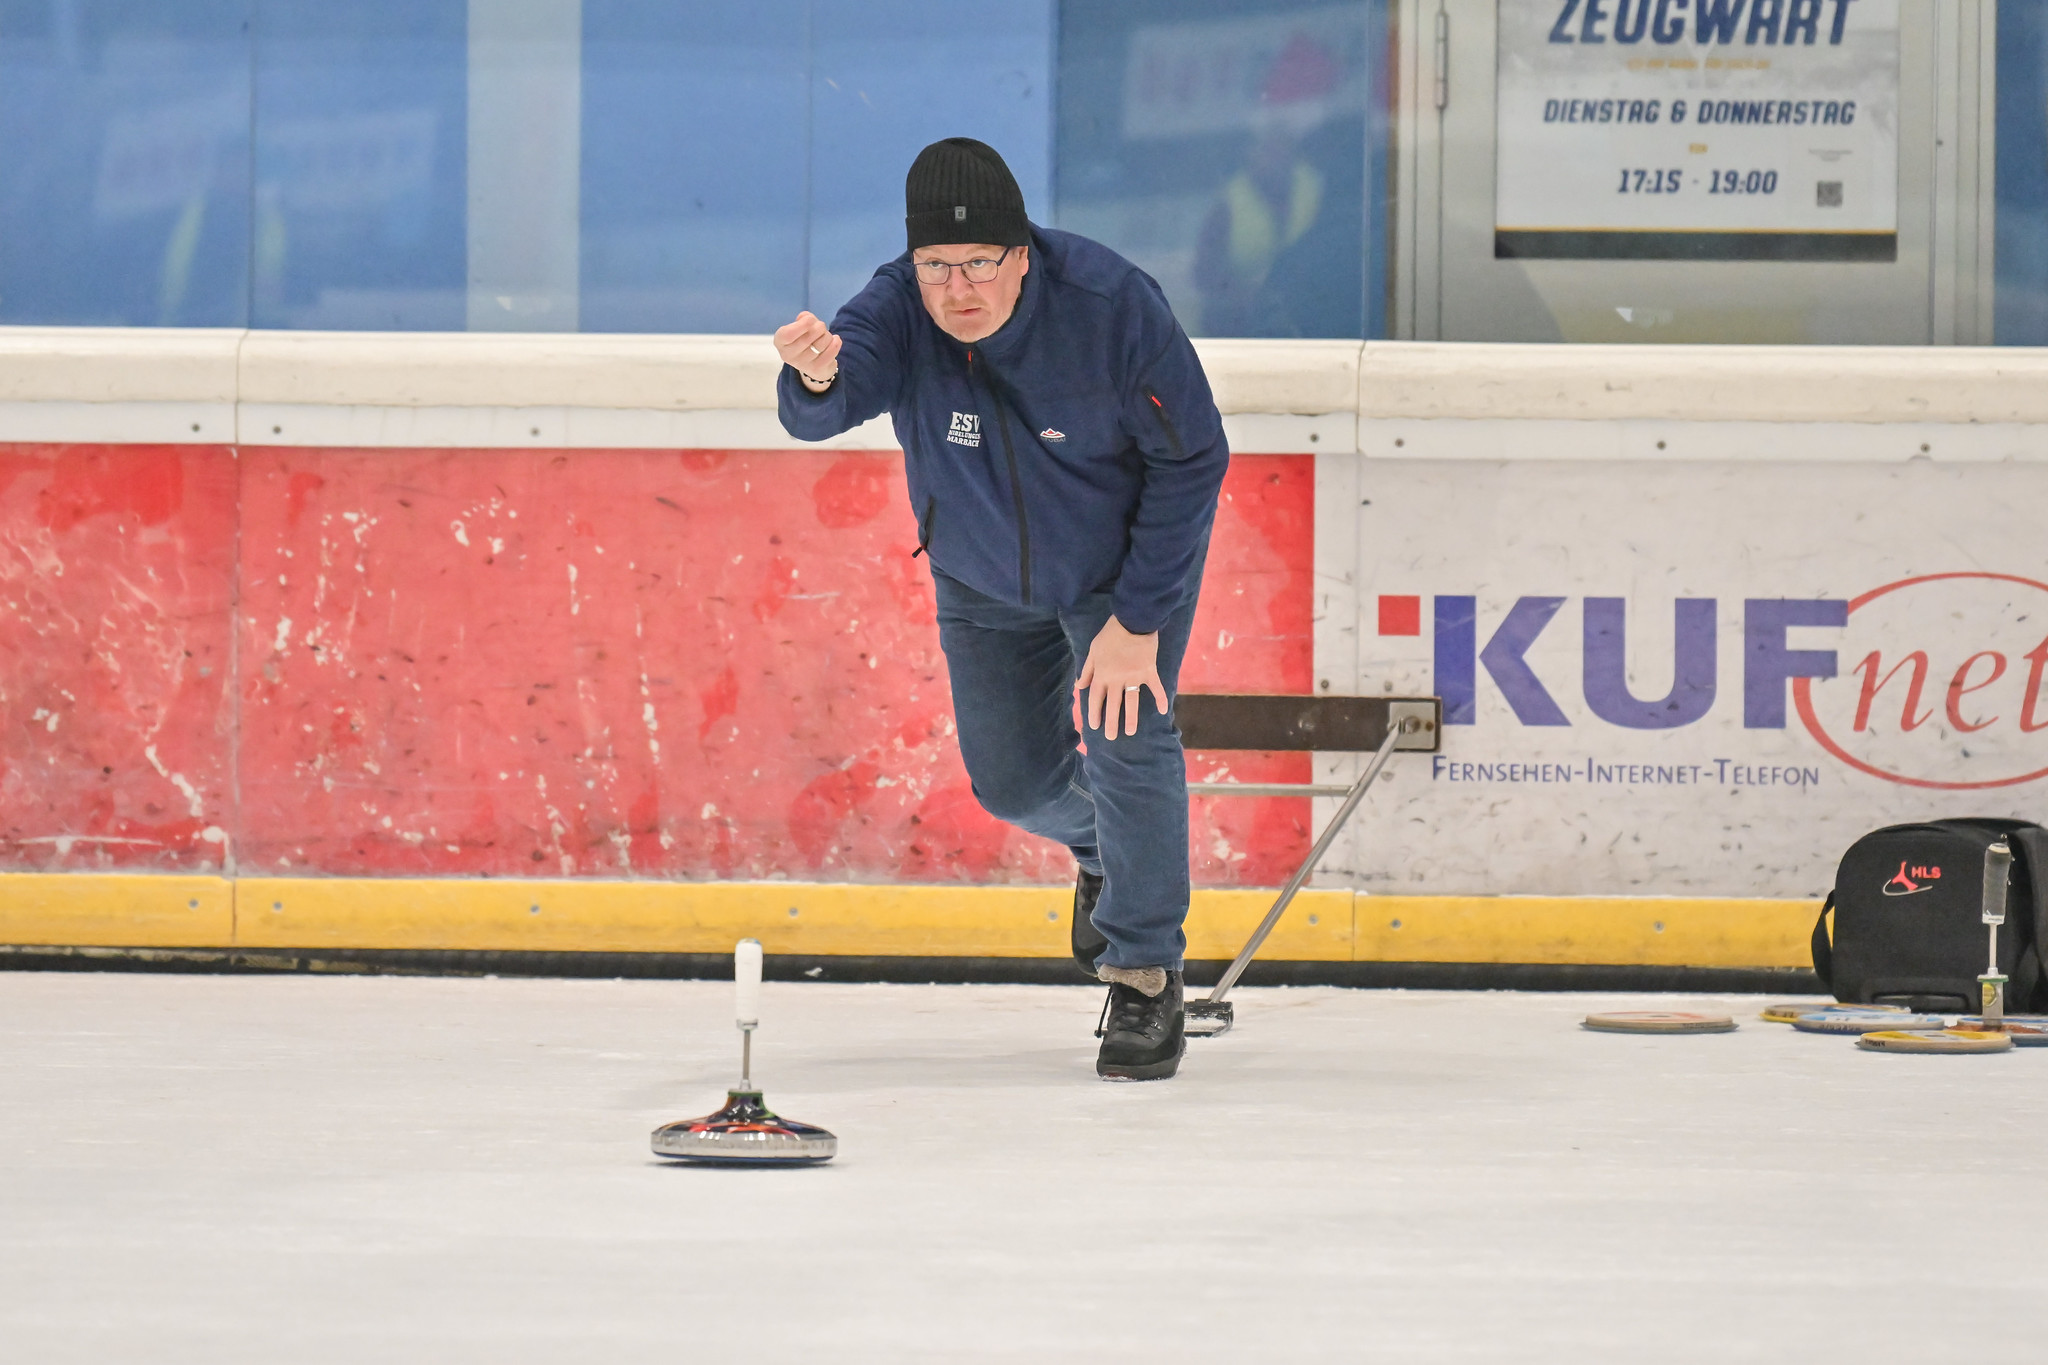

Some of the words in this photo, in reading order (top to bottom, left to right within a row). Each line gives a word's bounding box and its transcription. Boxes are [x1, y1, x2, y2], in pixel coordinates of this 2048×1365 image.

[1548, 0, 1856, 46] ZEUGWART
[1543, 99, 1659, 125] DIENSTAG
[1670, 101, 1687, 125] &
[1697, 101, 1856, 126] DONNERSTAG
[1617, 169, 1682, 194] 17:15
[1708, 170, 1778, 194] 19:00
[950, 411, 980, 433] ESV
[1434, 595, 1849, 730] KUF
[1852, 635, 2048, 733] net
[1911, 866, 1942, 879] HLS
